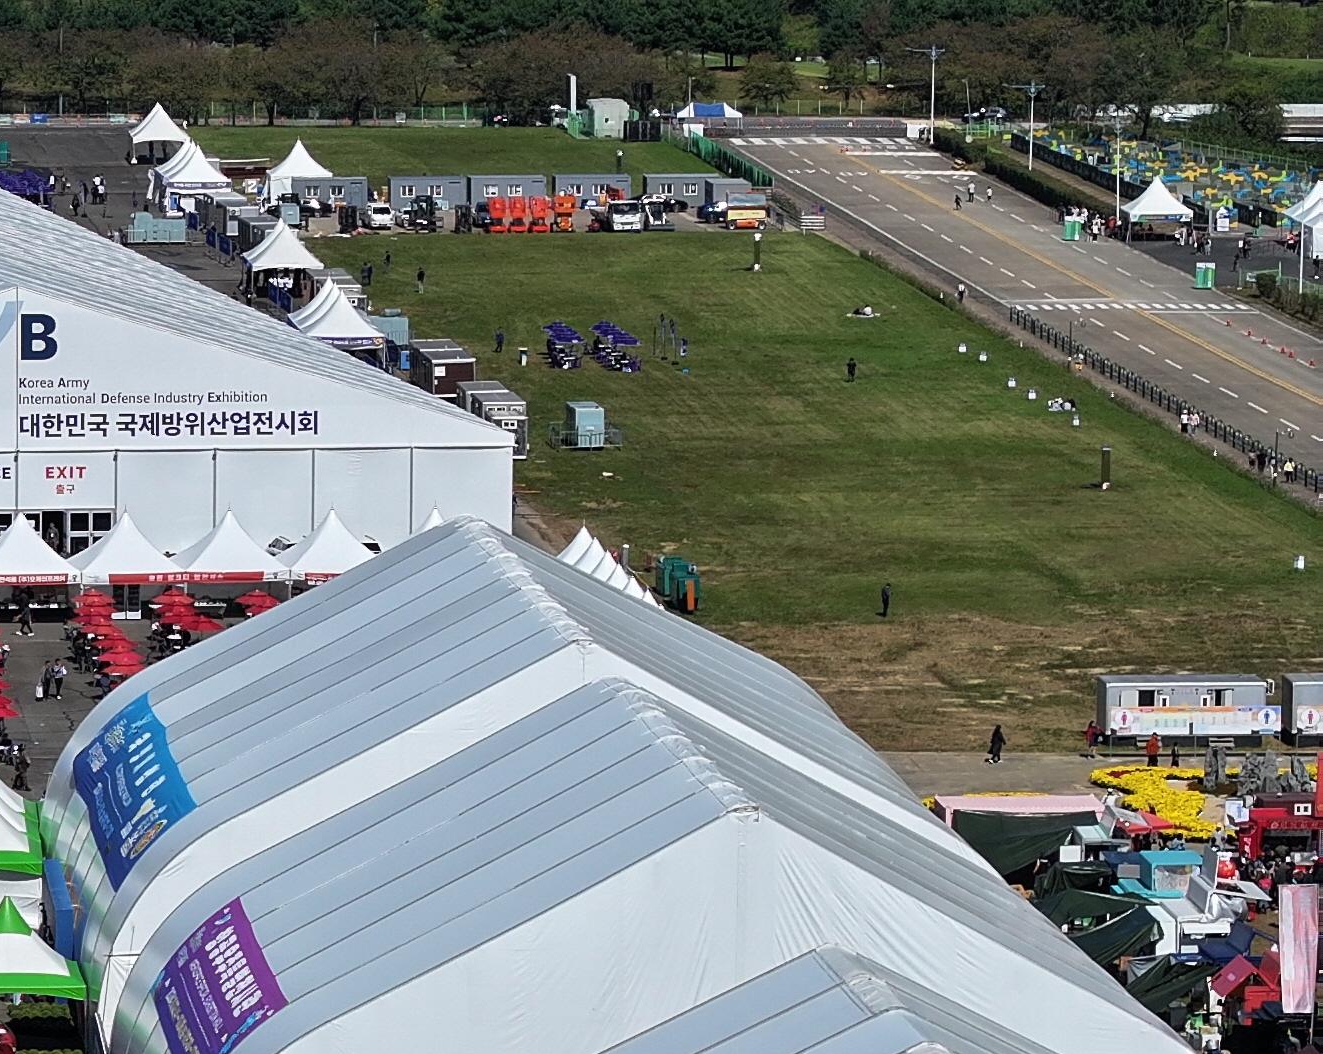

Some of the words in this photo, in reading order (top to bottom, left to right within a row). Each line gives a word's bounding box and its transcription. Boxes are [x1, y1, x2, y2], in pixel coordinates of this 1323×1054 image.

[20, 314, 58, 361] B
[18, 377, 54, 389] Korea
[57, 377, 90, 391] Army
[18, 393, 96, 405] International
[101, 393, 151, 404] Defense
[154, 392, 204, 406] Industry
[207, 391, 268, 403] Exhibition
[19, 413, 110, 439] 대한민국
[115, 410, 319, 436] 국제방위산업전시회
[45, 466, 87, 479] EXIT
[55, 484, 75, 495] 출구
